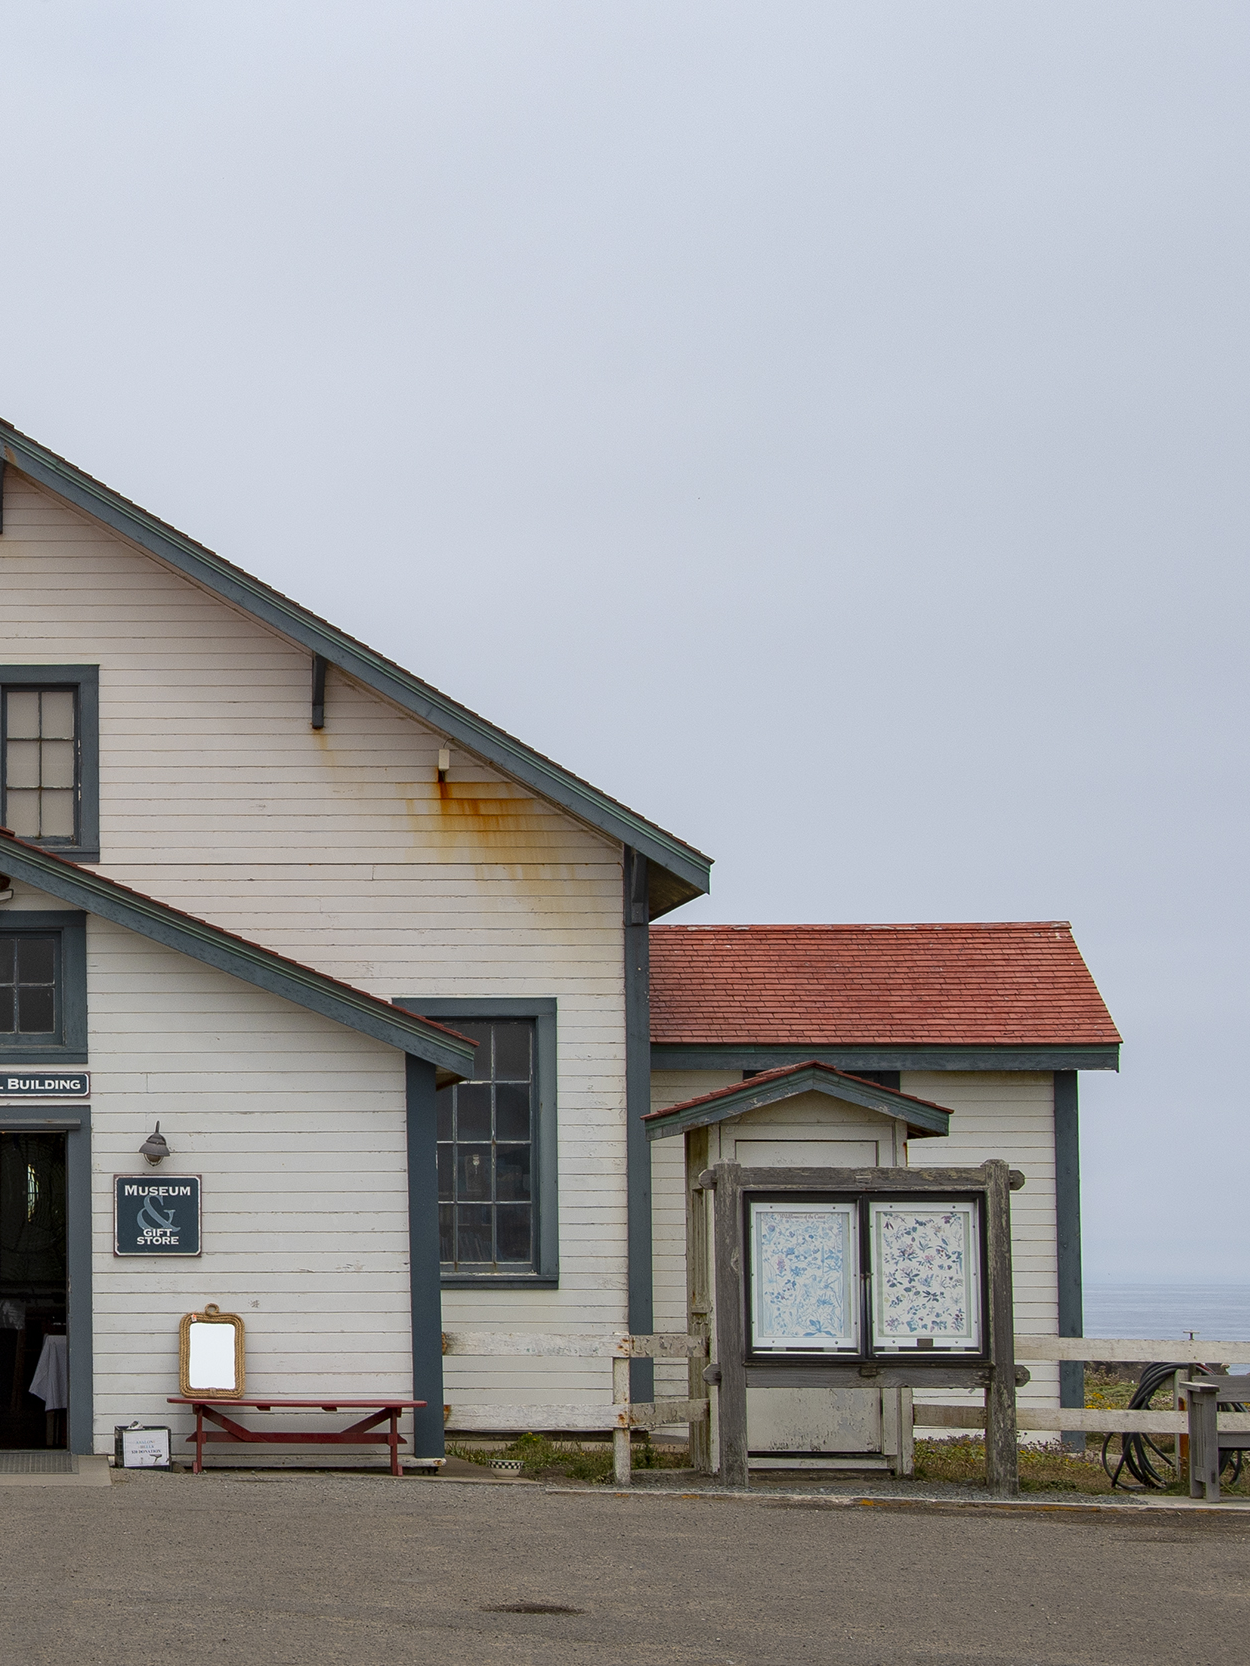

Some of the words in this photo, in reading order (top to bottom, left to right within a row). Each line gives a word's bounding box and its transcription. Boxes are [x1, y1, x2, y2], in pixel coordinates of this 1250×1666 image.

[7, 1078, 81, 1090] BUILDING
[124, 1184, 191, 1196] MUSEUM
[136, 1194, 181, 1233] &
[143, 1228, 173, 1237] GIFT
[136, 1236, 180, 1245] STORE
